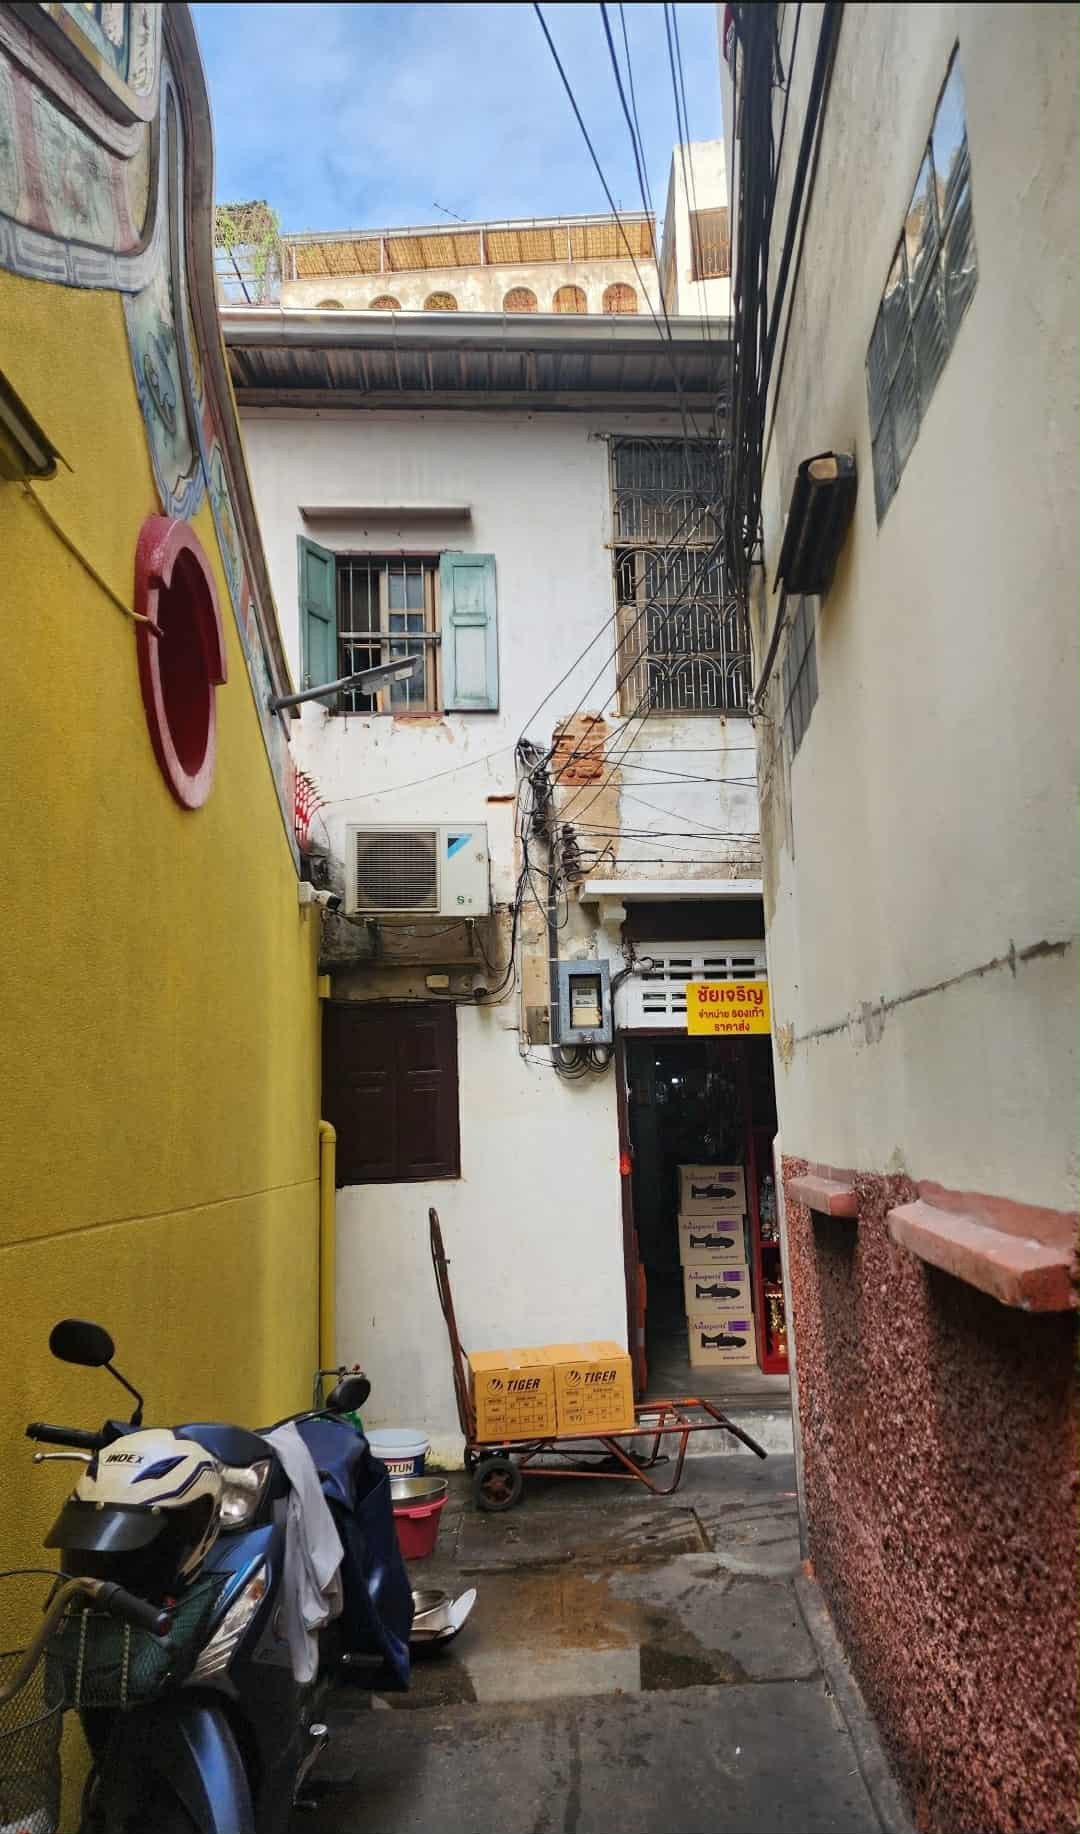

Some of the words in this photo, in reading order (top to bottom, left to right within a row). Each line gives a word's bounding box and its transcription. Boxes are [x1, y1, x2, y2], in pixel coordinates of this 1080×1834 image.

[697, 986, 764, 1005] ชัยเจริญ
[699, 1008, 730, 1019] จำหน่าย
[731, 1006, 765, 1018] รองเท้า
[714, 1019, 751, 1032] ราคาส่ง
[584, 1370, 617, 1383] TIGER
[506, 1378, 541, 1391] TIGER
[105, 1453, 145, 1464] INDEX
[385, 1462, 413, 1473] OTUN
